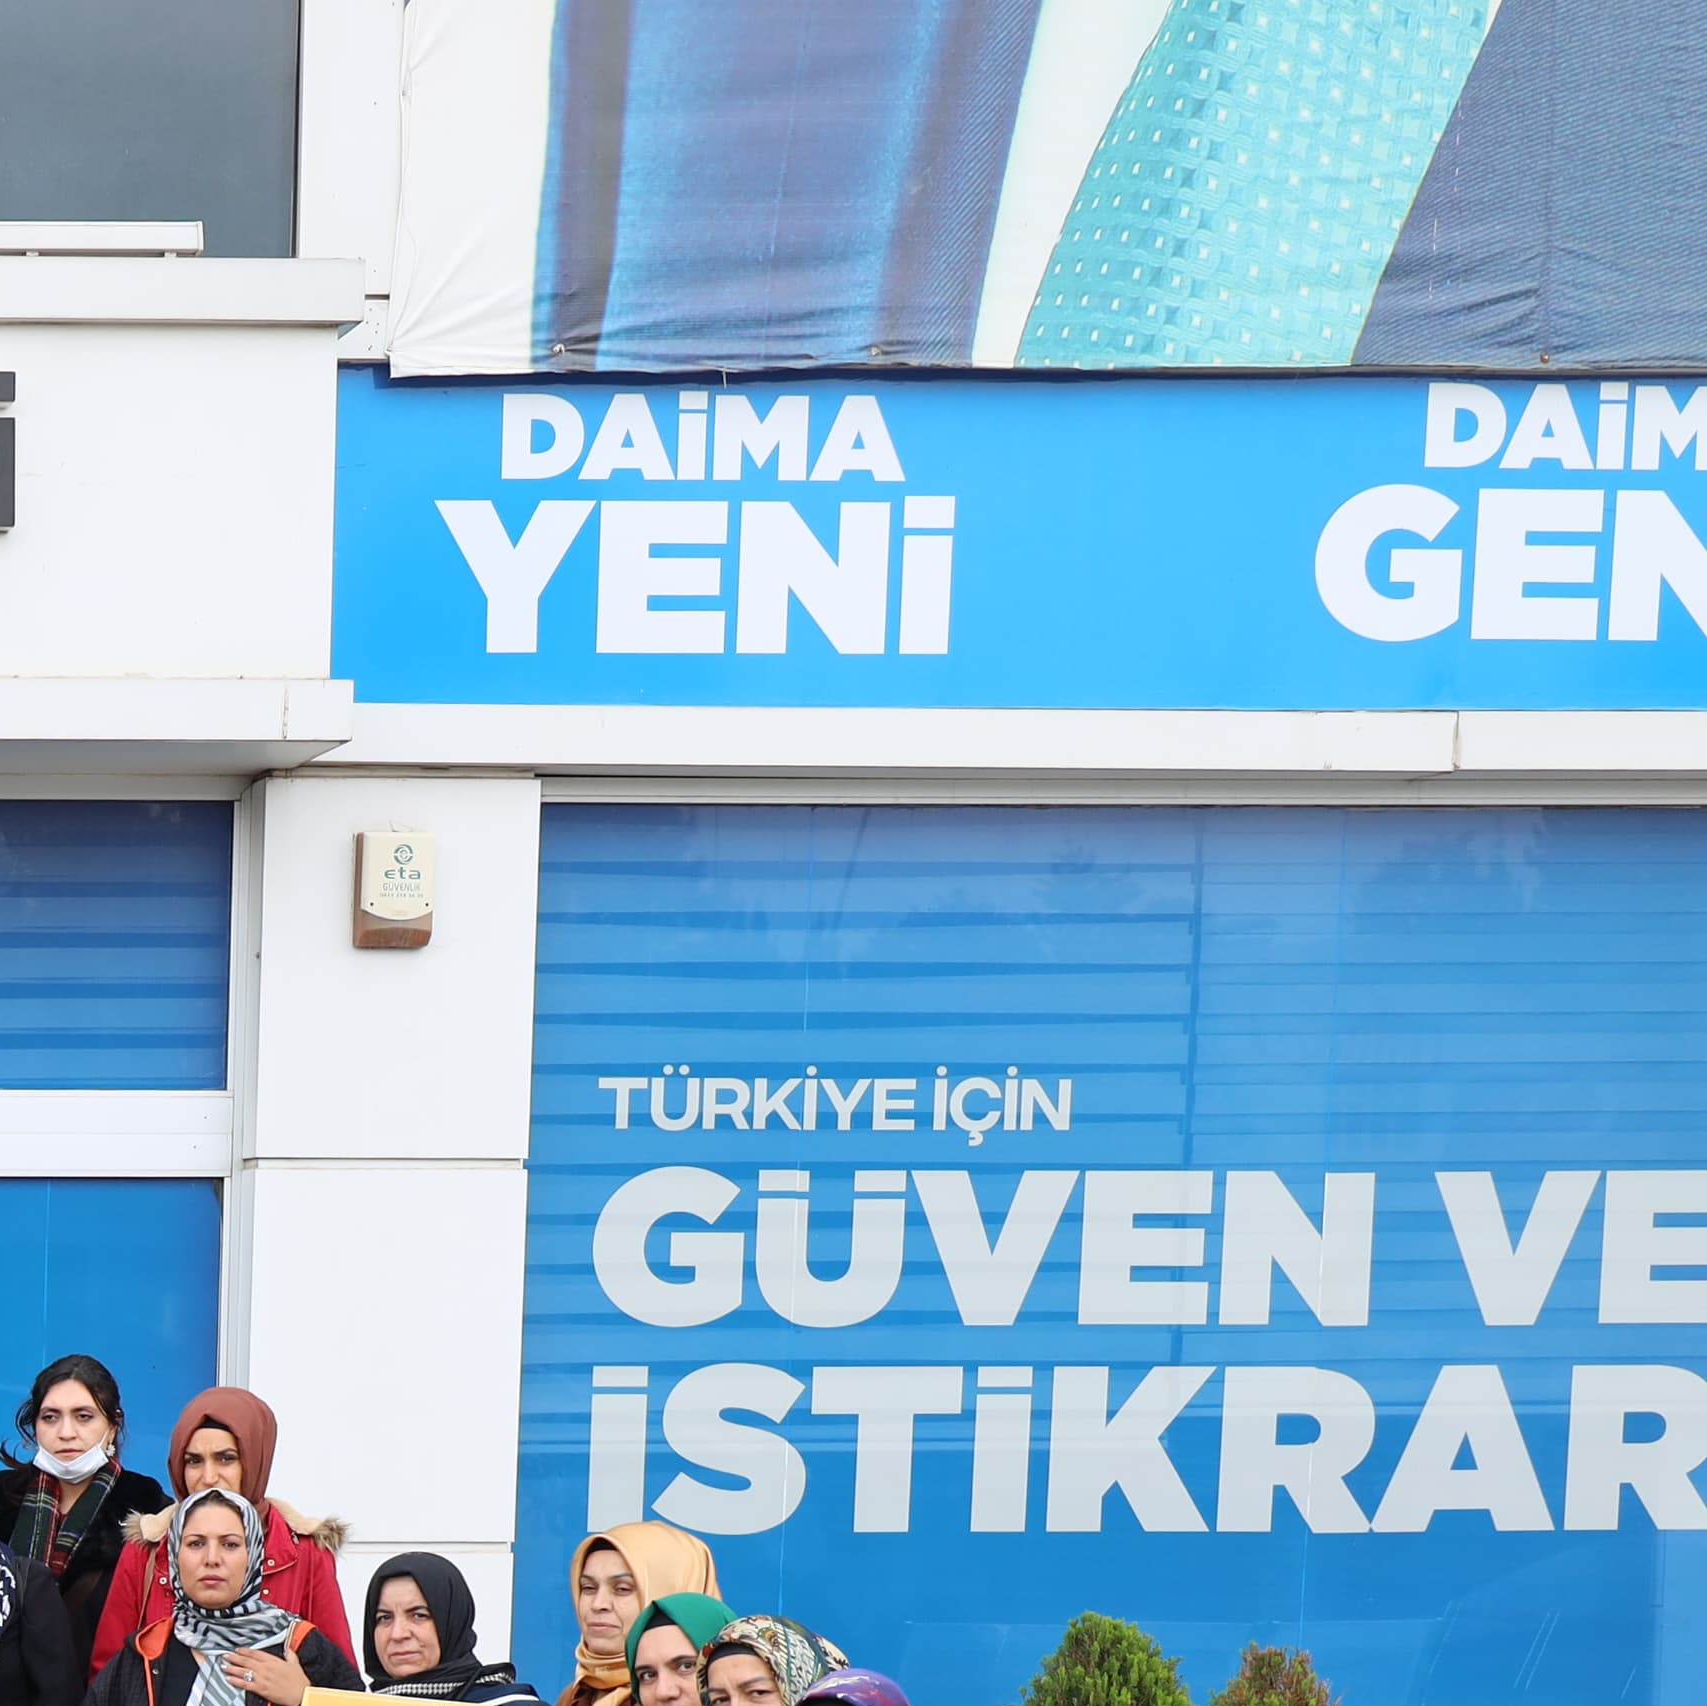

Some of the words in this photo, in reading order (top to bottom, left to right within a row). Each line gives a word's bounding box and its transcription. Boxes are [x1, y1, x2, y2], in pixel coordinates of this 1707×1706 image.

[384, 866, 421, 879] eta
[599, 1065, 915, 1131] TÜRKİYE
[932, 1065, 1073, 1146] İÇİN
[592, 1166, 1374, 1328] GÜVEN
[1435, 1170, 1707, 1325] VE
